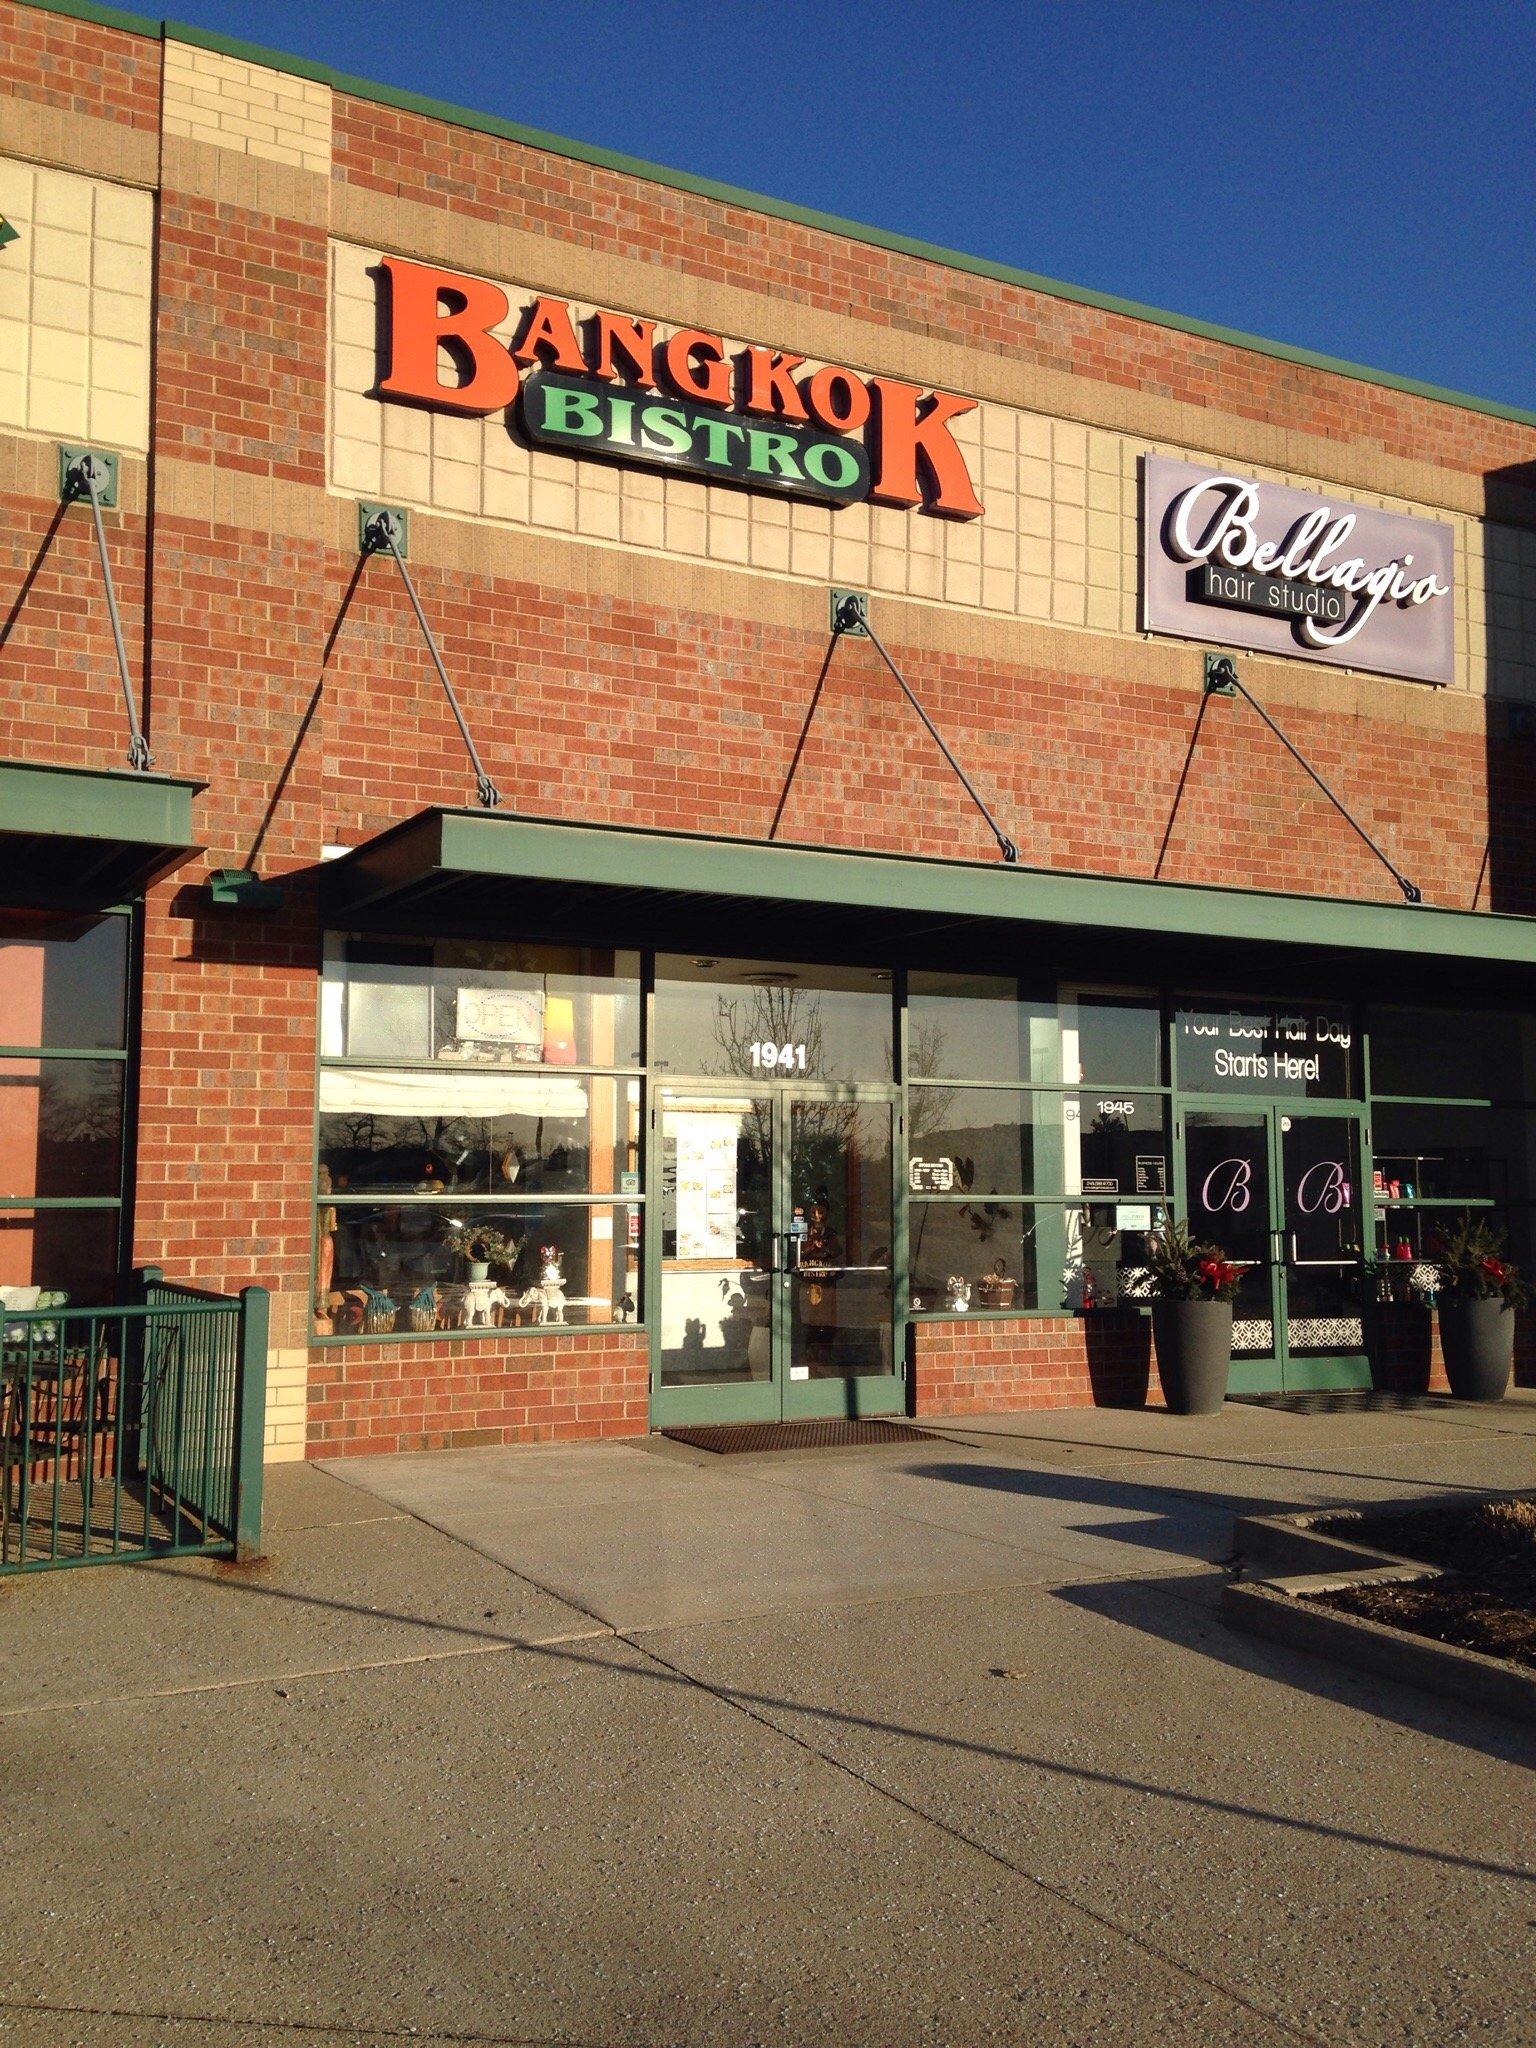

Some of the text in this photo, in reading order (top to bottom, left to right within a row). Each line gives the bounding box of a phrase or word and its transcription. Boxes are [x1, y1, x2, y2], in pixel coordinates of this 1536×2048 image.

[380, 255, 986, 515] BANGKOK
[540, 384, 860, 488] BISTRO
[1175, 475, 1450, 646] Bellagio
[1208, 567, 1341, 619] hair studio
[1180, 1008, 1351, 1049] Your Best Hair Day
[749, 1041, 806, 1070] 1941
[1214, 1048, 1320, 1082] Starts Here!
[1096, 1100, 1135, 1115] 1945
[1201, 1158, 1251, 1212] B
[1297, 1161, 1344, 1214] B
